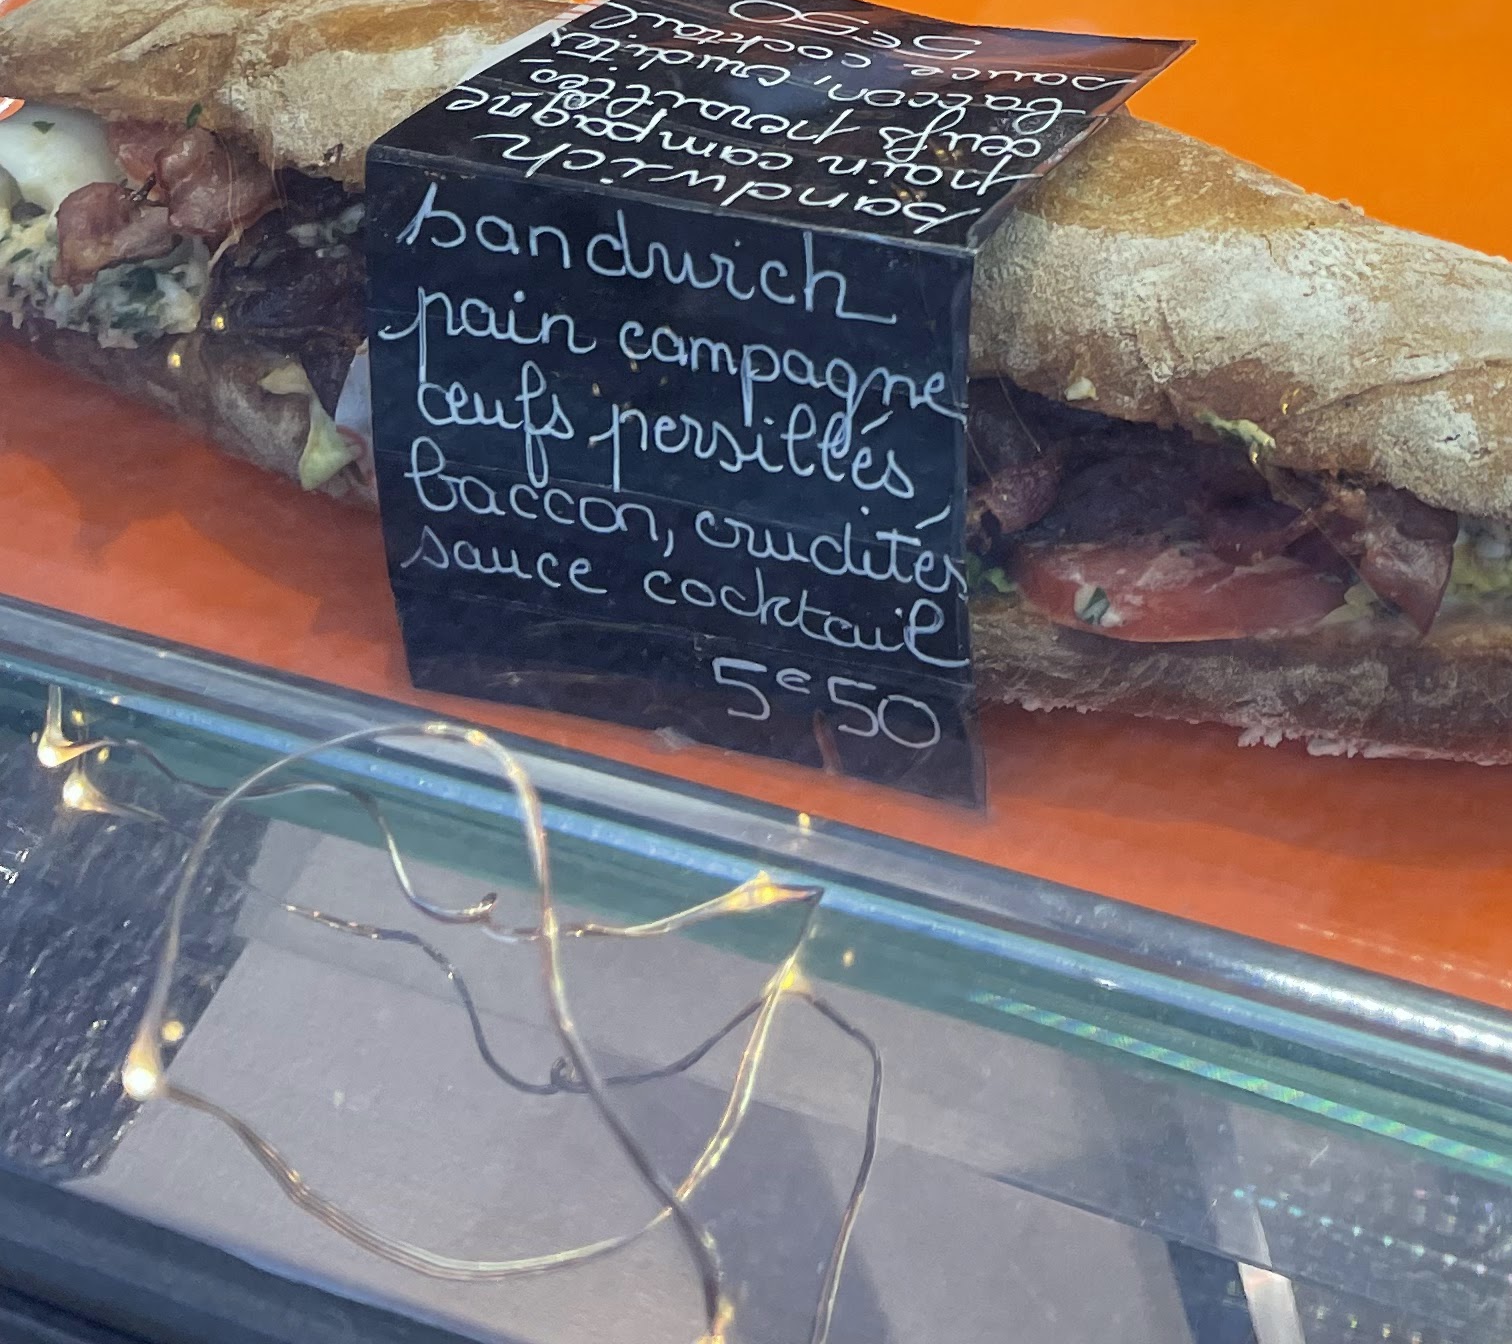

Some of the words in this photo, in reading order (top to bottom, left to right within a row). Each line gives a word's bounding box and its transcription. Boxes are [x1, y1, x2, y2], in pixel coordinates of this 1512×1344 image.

[903, 63, 1137, 91] sauce
[470, 133, 979, 234] sandwich
[816, 154, 1044, 196] pain
[397, 182, 896, 323] sandwich
[378, 286, 597, 383] pain
[619, 319, 968, 456] campagne
[590, 402, 915, 499] persillés
[400, 524, 608, 594] sauce
[643, 568, 970, 669] cocktail
